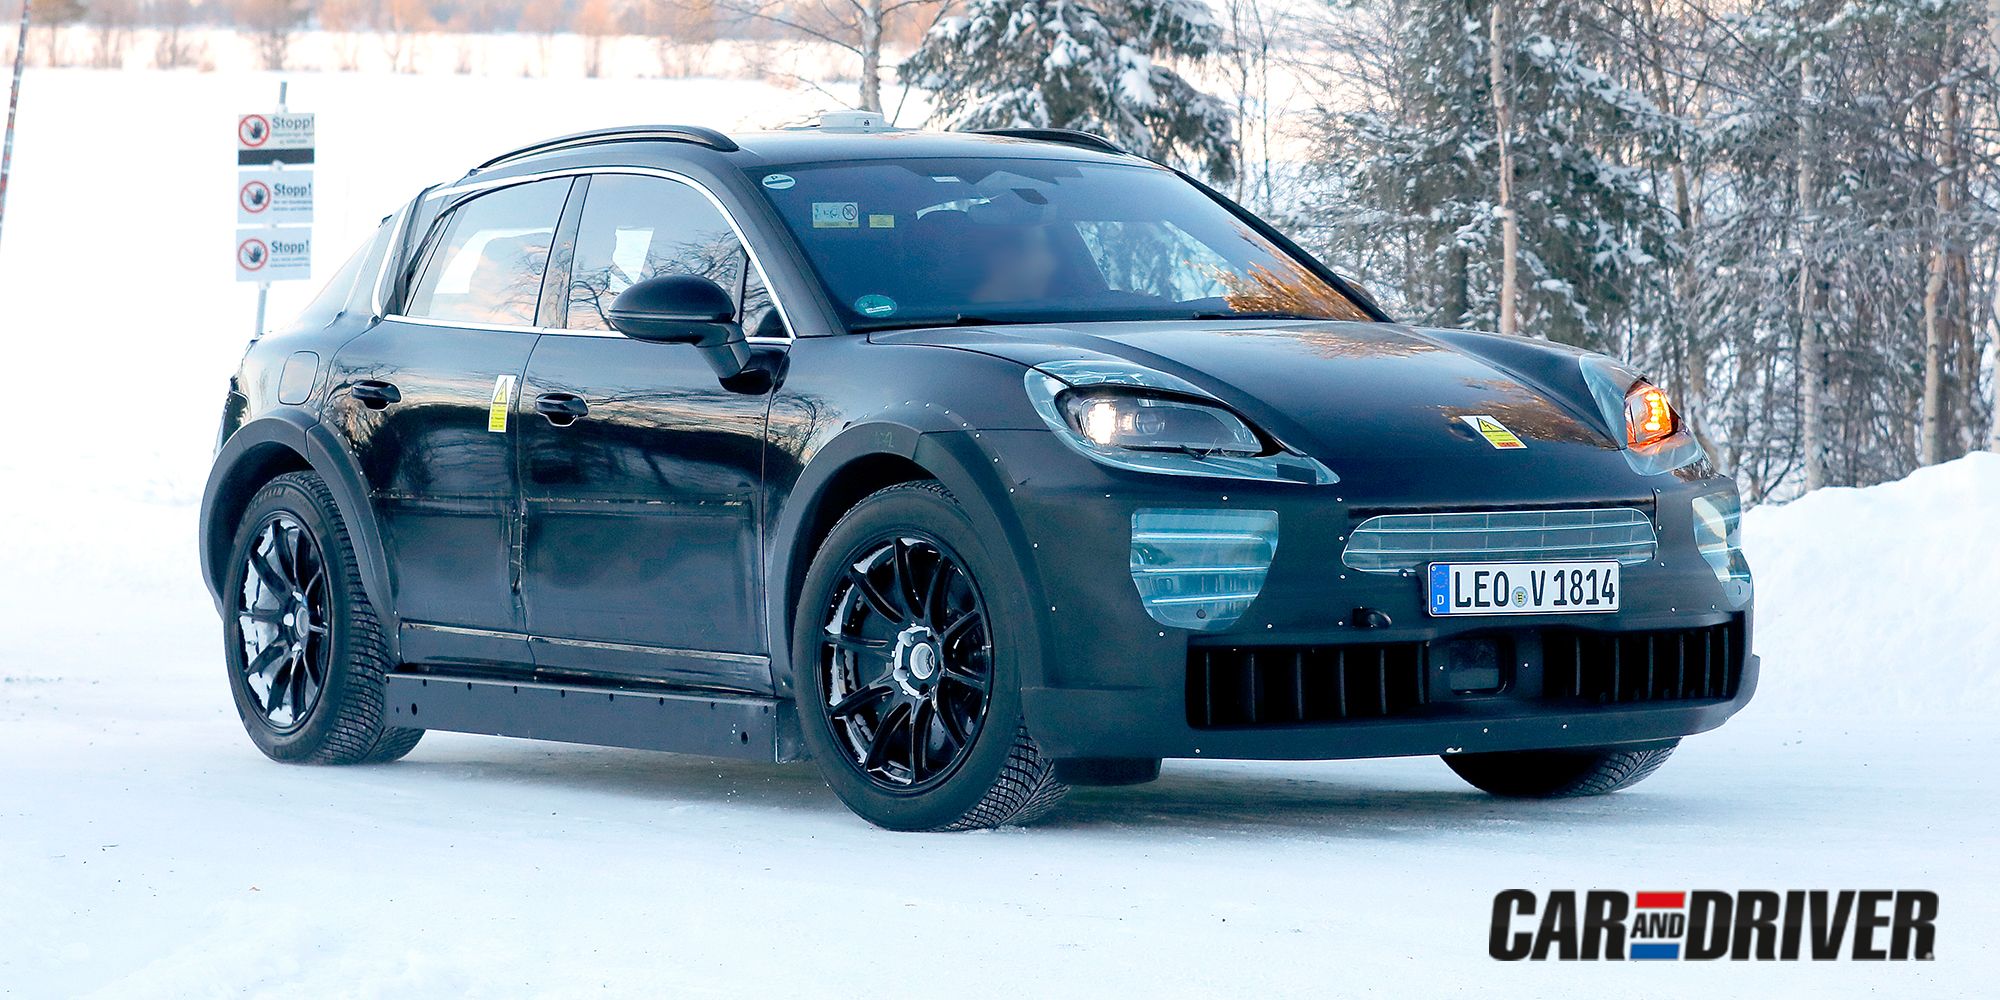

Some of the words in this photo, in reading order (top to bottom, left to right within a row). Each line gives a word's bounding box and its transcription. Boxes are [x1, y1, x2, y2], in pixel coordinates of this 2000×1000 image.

[273, 116, 314, 130] Stopp!
[273, 183, 312, 197] Stopp!
[271, 240, 310, 255] Stopp!
[1455, 570, 1509, 607] LEO
[1531, 570, 1546, 606] V
[1553, 569, 1615, 606] 1814
[1437, 594, 1445, 605] D
